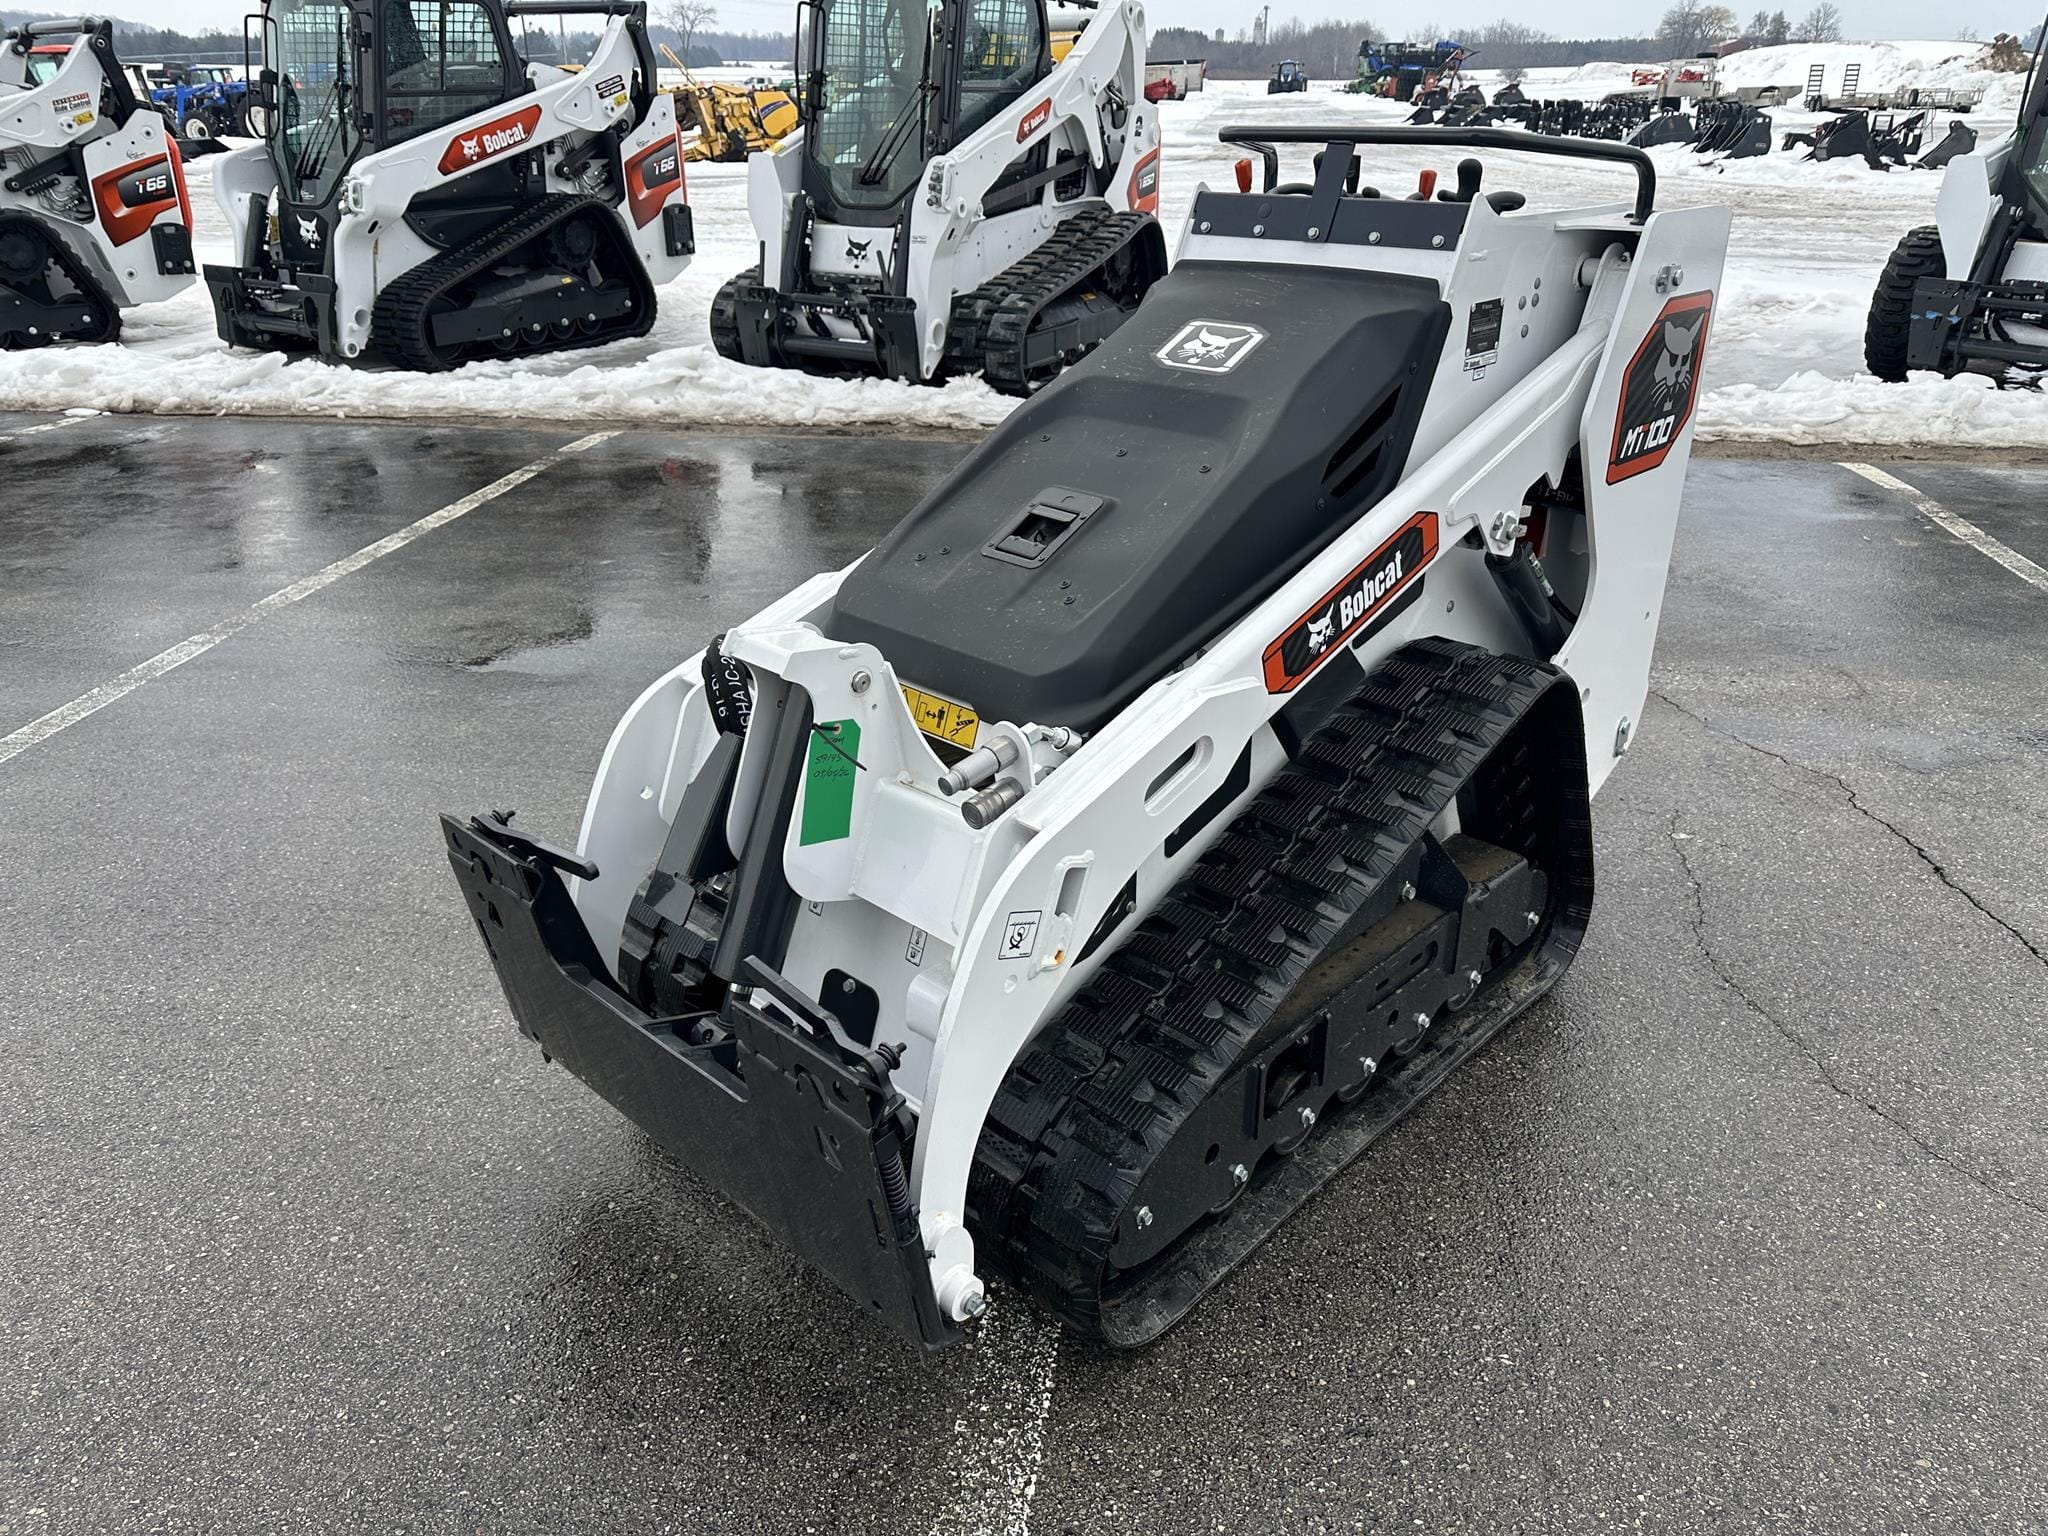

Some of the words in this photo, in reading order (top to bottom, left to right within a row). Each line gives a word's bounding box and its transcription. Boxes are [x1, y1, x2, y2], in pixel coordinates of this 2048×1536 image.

[1030, 110, 1045, 129] Bobcat
[482, 122, 527, 154] Bobcat
[654, 156, 675, 175] T66
[135, 175, 167, 194] T66
[1620, 414, 1675, 459] MT100
[1339, 550, 1403, 631] Bobcat
